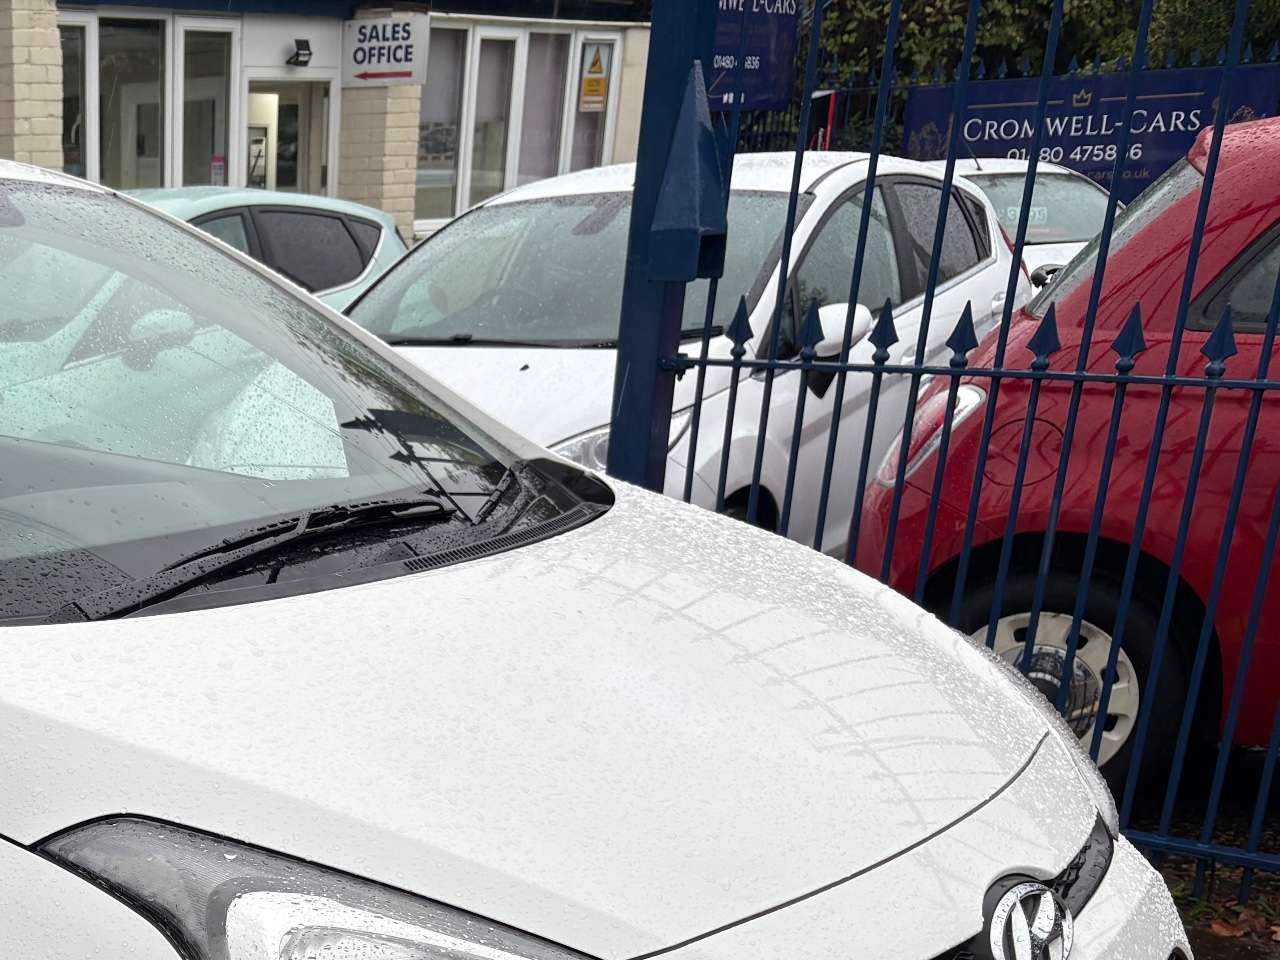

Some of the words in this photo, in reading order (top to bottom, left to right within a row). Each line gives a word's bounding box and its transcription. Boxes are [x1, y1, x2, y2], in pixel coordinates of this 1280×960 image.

[357, 22, 411, 43] SALES
[353, 44, 414, 65] OFFICE
[1007, 145, 1064, 162] 0180
[1070, 143, 1143, 161] 47586
